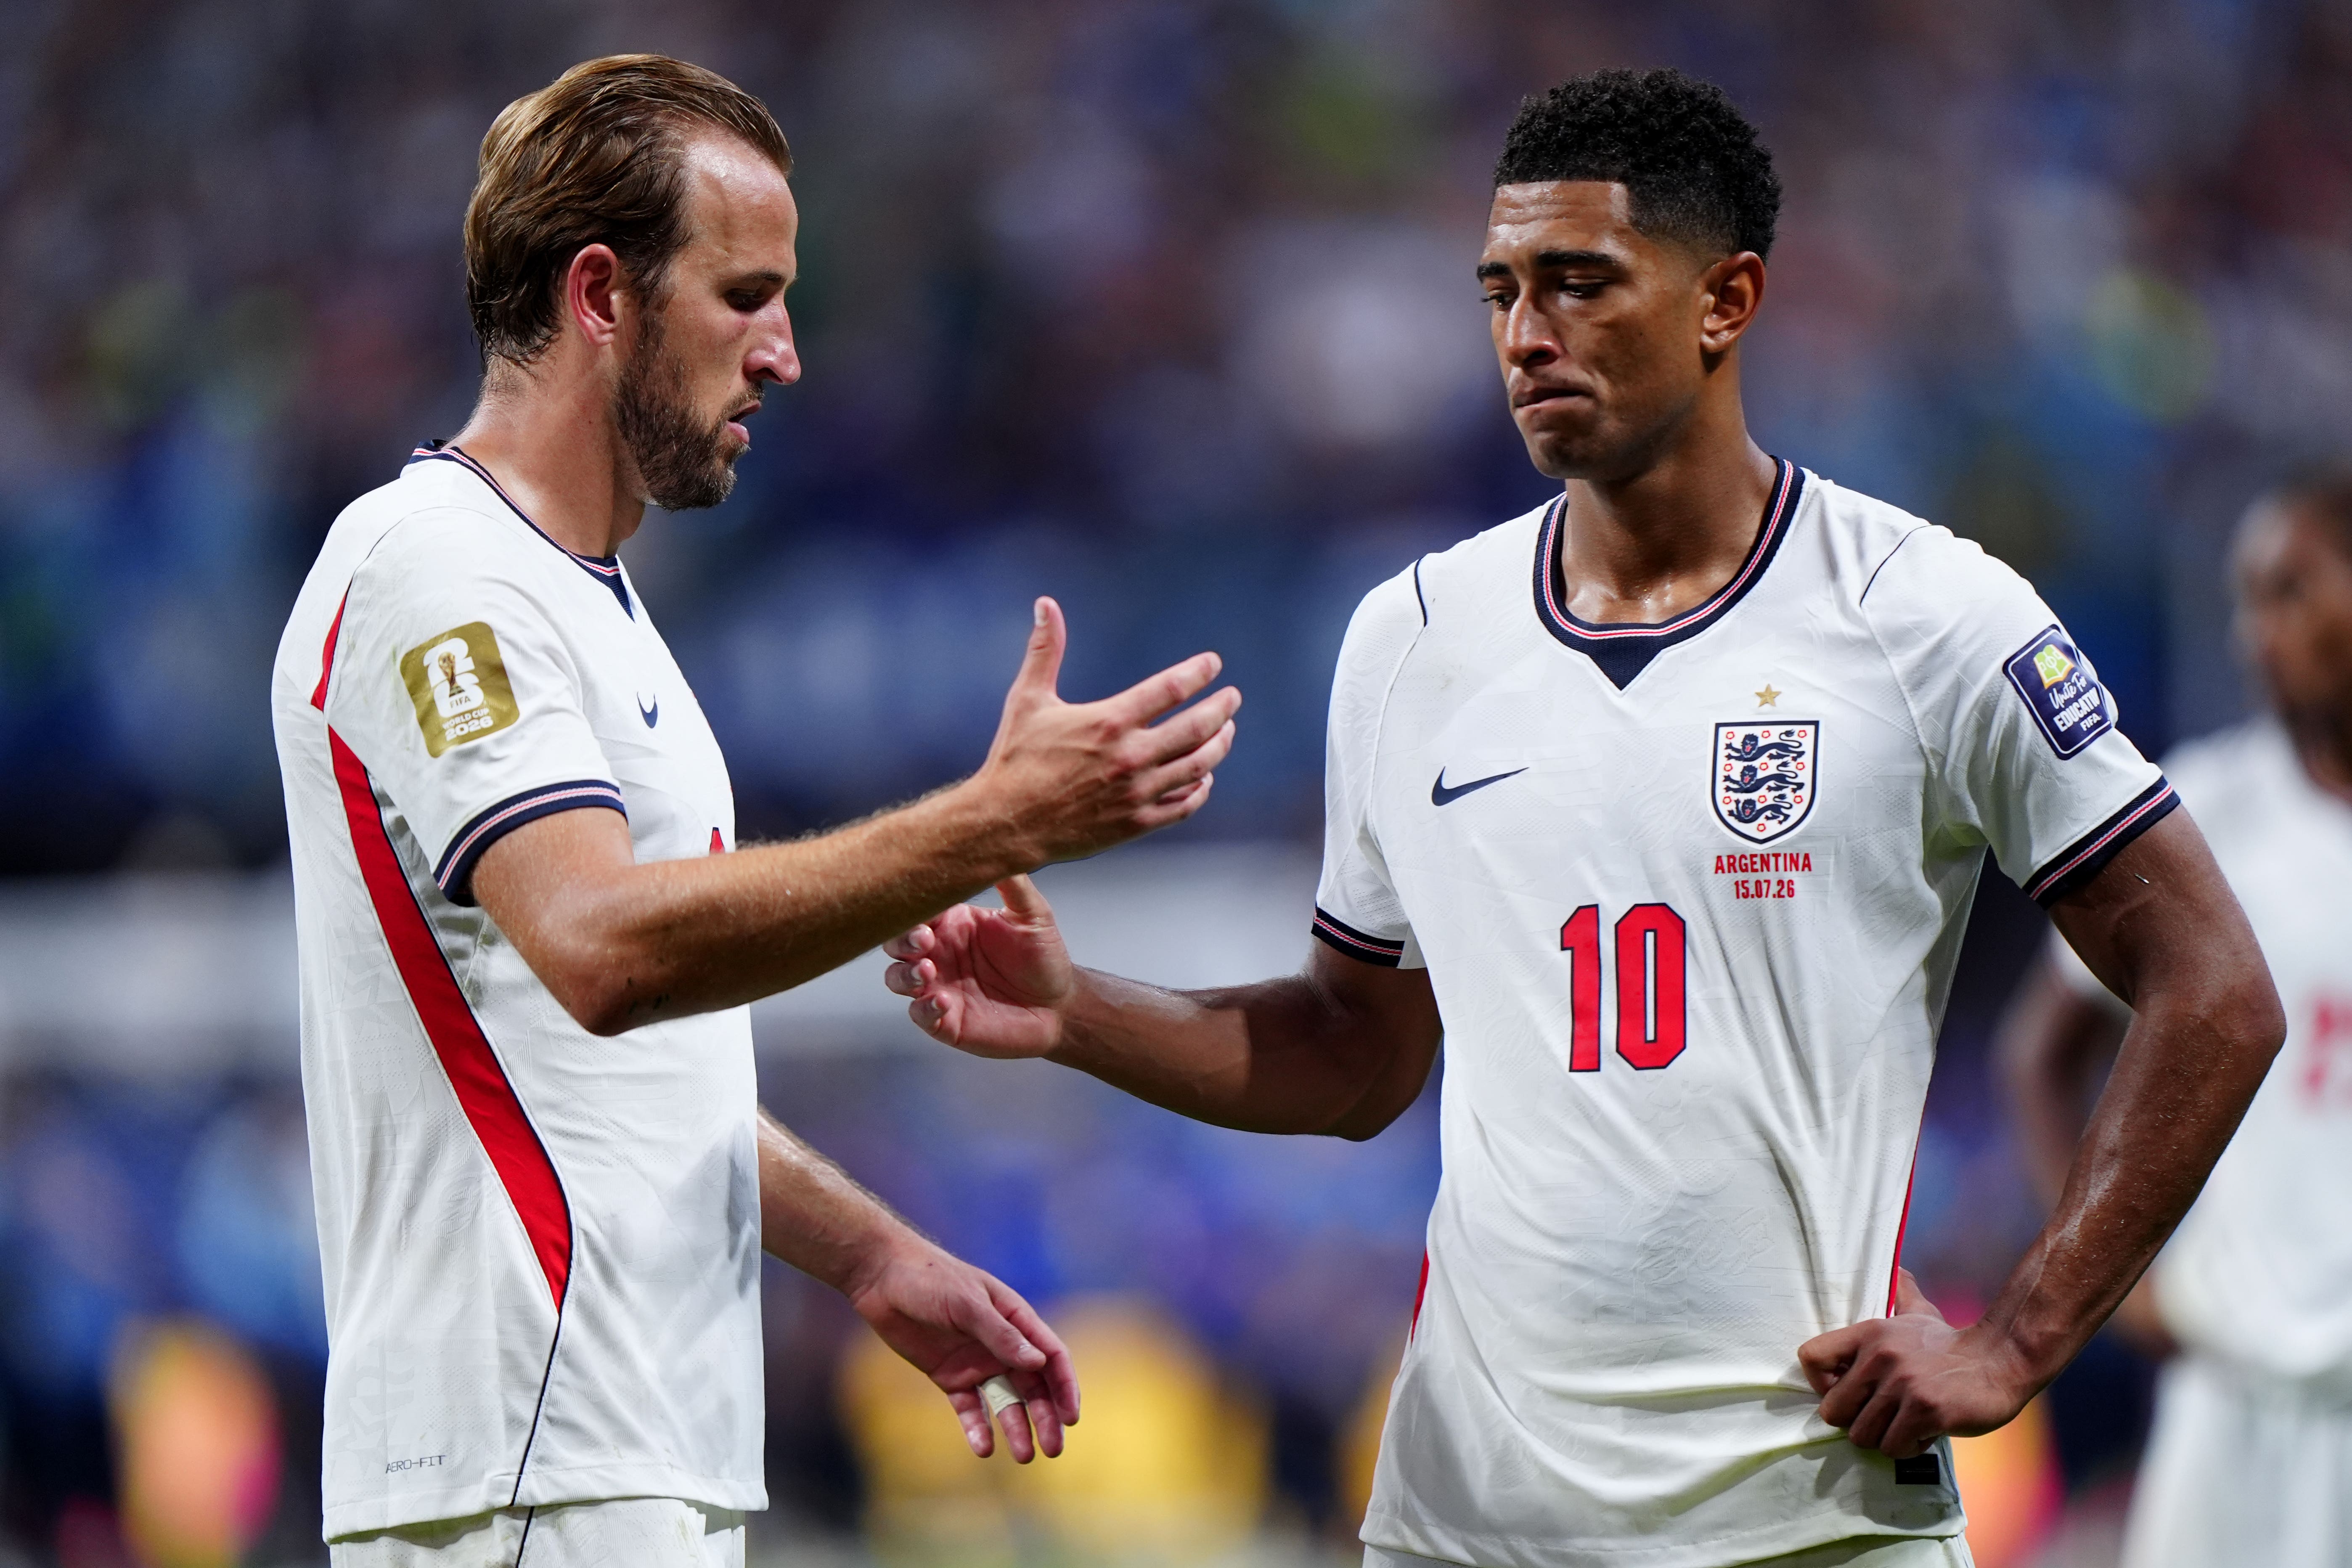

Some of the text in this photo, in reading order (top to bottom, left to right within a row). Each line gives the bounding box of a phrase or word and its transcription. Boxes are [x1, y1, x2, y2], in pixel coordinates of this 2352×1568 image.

[450, 695, 471, 708] FIFA
[2049, 682, 2077, 709] Unite
[442, 707, 490, 729] WORLD CUP
[445, 715, 493, 742] 2026
[2080, 713, 2101, 731] FIFA
[1714, 853, 1812, 874] ARGENTINA
[1734, 879, 1795, 899] 15.07.26
[1560, 903, 1687, 1072] 10
[386, 1455, 447, 1474] AERO-FIT
